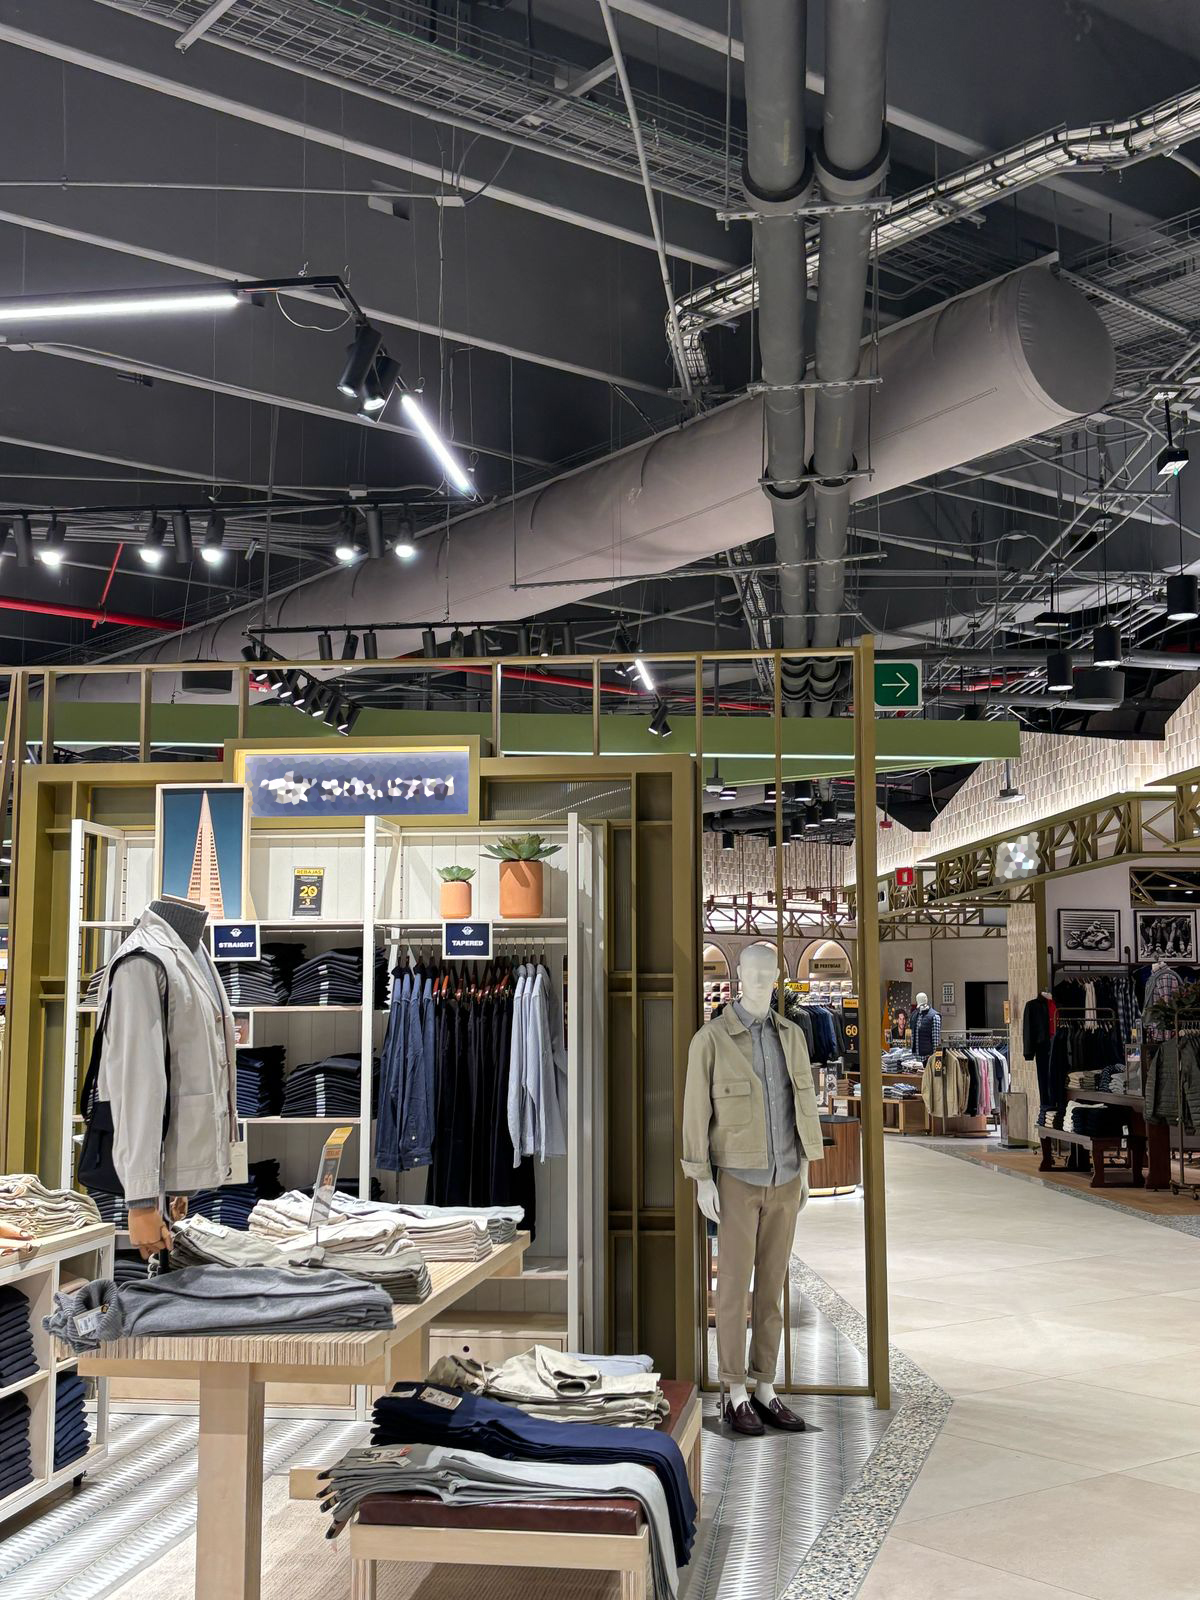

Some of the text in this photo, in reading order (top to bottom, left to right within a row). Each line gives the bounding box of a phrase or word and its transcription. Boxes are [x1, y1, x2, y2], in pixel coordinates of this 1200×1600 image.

[299, 885, 318, 897] 20
[218, 941, 254, 949] STRAIGHT
[845, 1024, 858, 1037] 60
